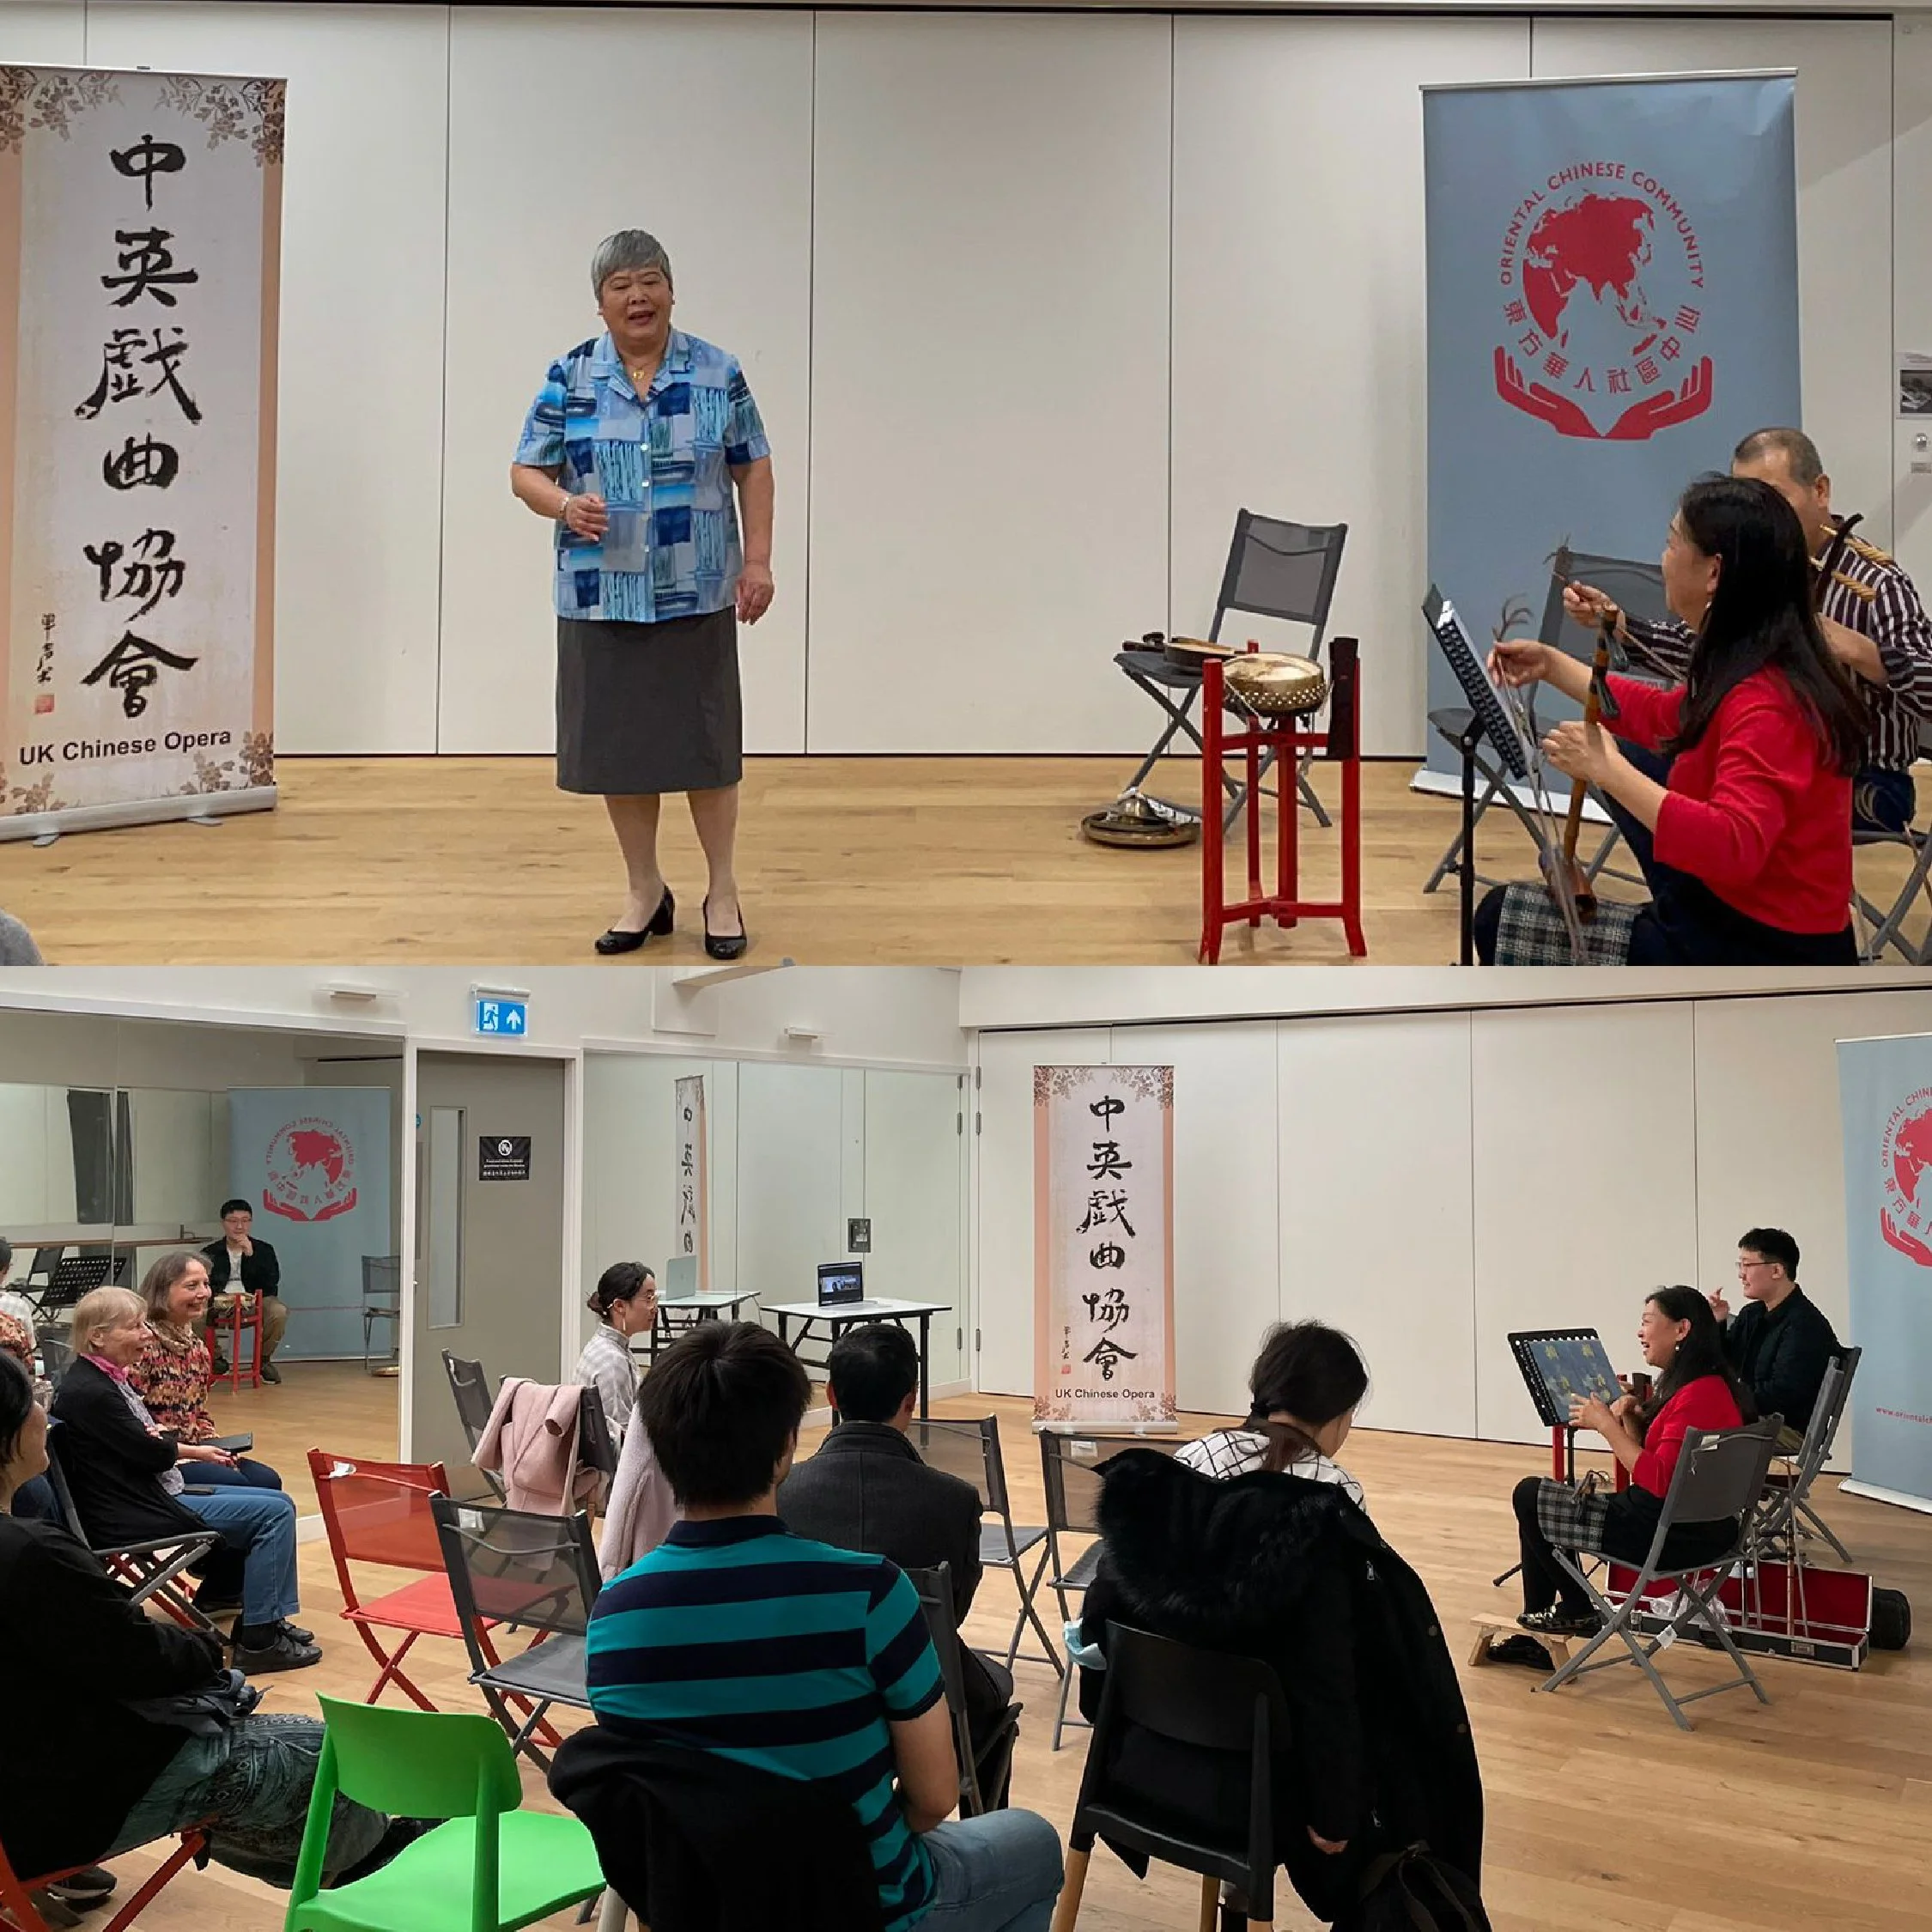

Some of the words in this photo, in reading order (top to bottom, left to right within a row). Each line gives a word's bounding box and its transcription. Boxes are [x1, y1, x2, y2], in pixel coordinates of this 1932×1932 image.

[1500, 189, 1546, 286] ORIENTAL
[1547, 161, 1626, 191] CHINESE
[1632, 171, 1704, 289] COMMUNITY
[19, 744, 55, 766] UK
[62, 738, 157, 761] Chinese
[164, 730, 232, 753] Opera
[1881, 1105, 1905, 1169] ORIENTAL
[1055, 1388, 1072, 1399] UK
[1074, 1388, 1119, 1399] Chinese
[1122, 1388, 1156, 1400] Opera
